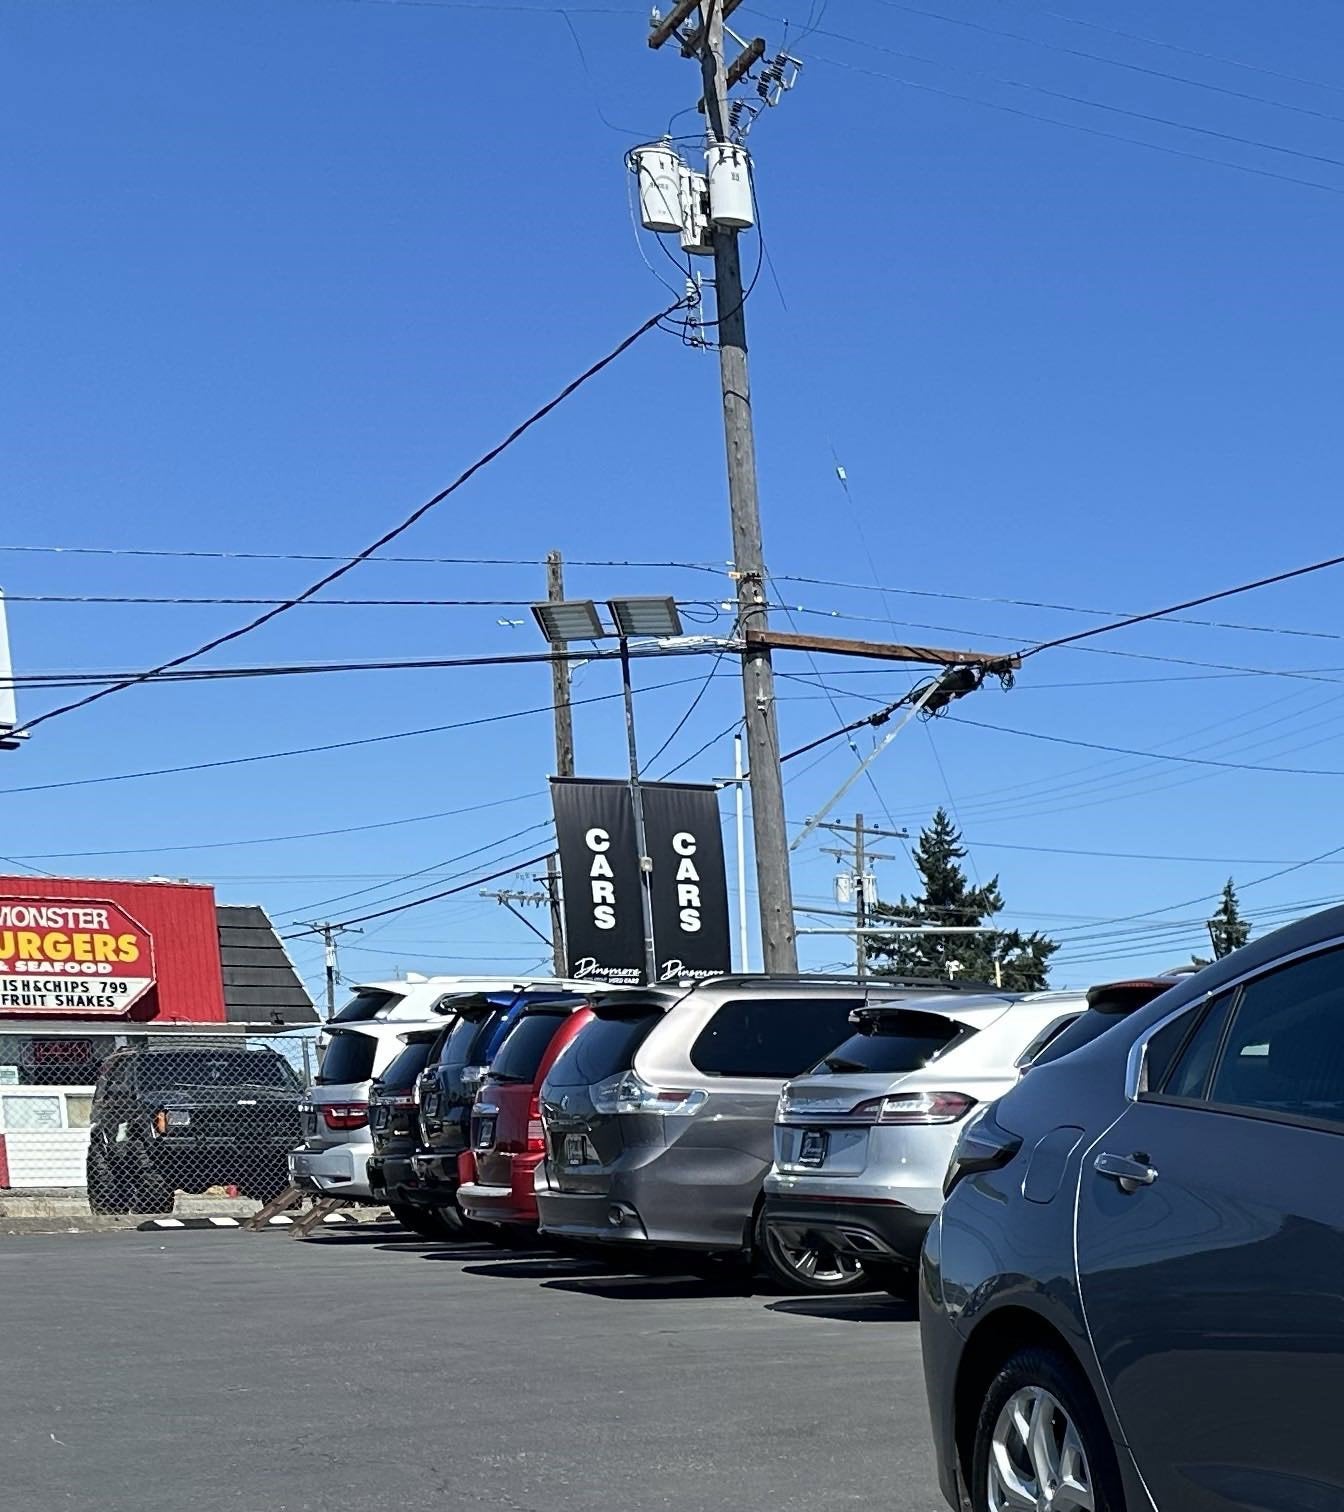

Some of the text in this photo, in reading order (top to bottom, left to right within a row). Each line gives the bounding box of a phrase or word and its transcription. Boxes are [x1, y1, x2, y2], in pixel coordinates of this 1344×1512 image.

[585, 828, 616, 930] CARS
[672, 832, 702, 932] CARS
[14, 961, 113, 974] SEAFOOD
[99, 981, 128, 994] 799
[2, 994, 115, 1007] FRUIT SHAKES
